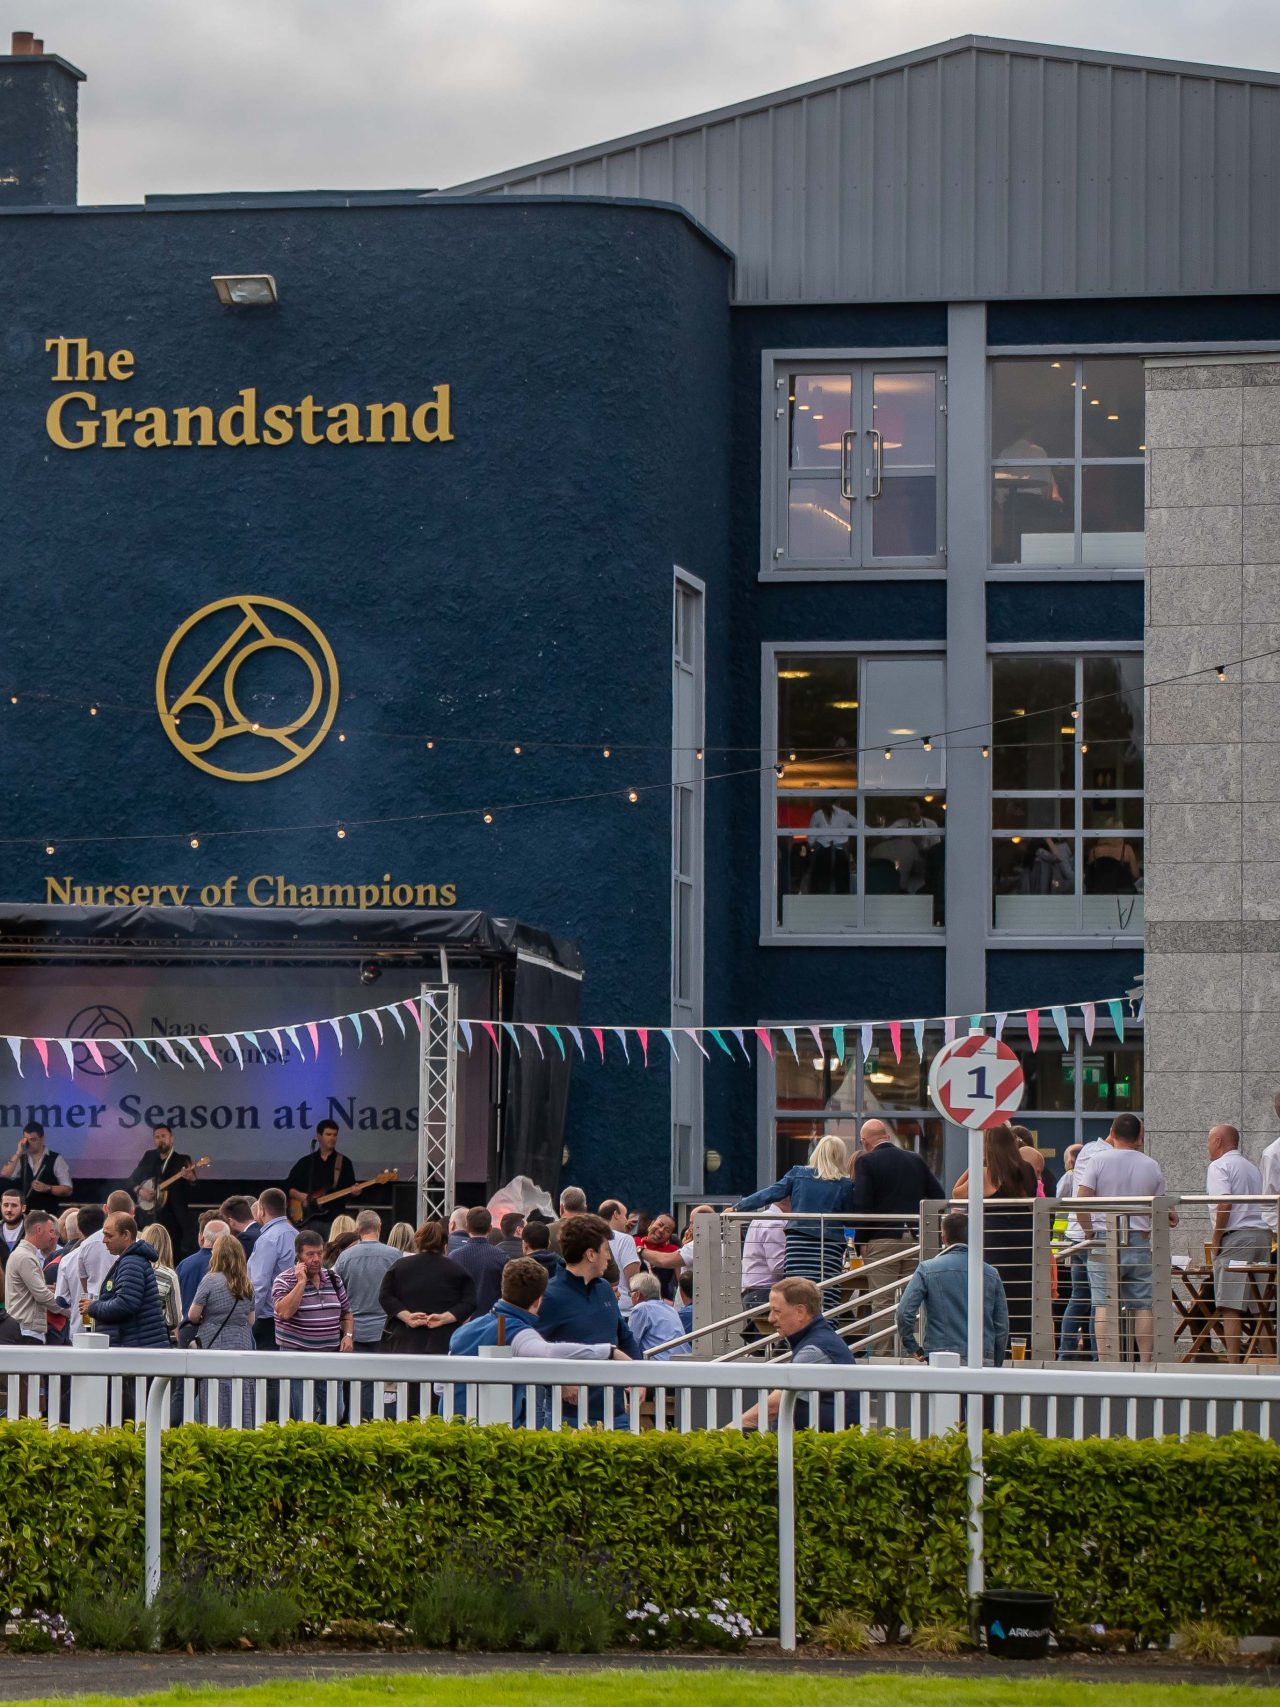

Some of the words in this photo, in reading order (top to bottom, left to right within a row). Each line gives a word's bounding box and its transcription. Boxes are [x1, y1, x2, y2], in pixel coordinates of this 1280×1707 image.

[45, 336, 135, 382] The
[45, 384, 455, 450] Grandstand
[44, 876, 189, 907] Nursery
[200, 875, 238, 907] of
[247, 873, 457, 910] Champions
[151, 1016, 209, 1037] Naas
[967, 1065, 994, 1100] 1
[118, 1094, 260, 1130] Season
[273, 1100, 313, 1130] at
[326, 1096, 420, 1132] Naas
